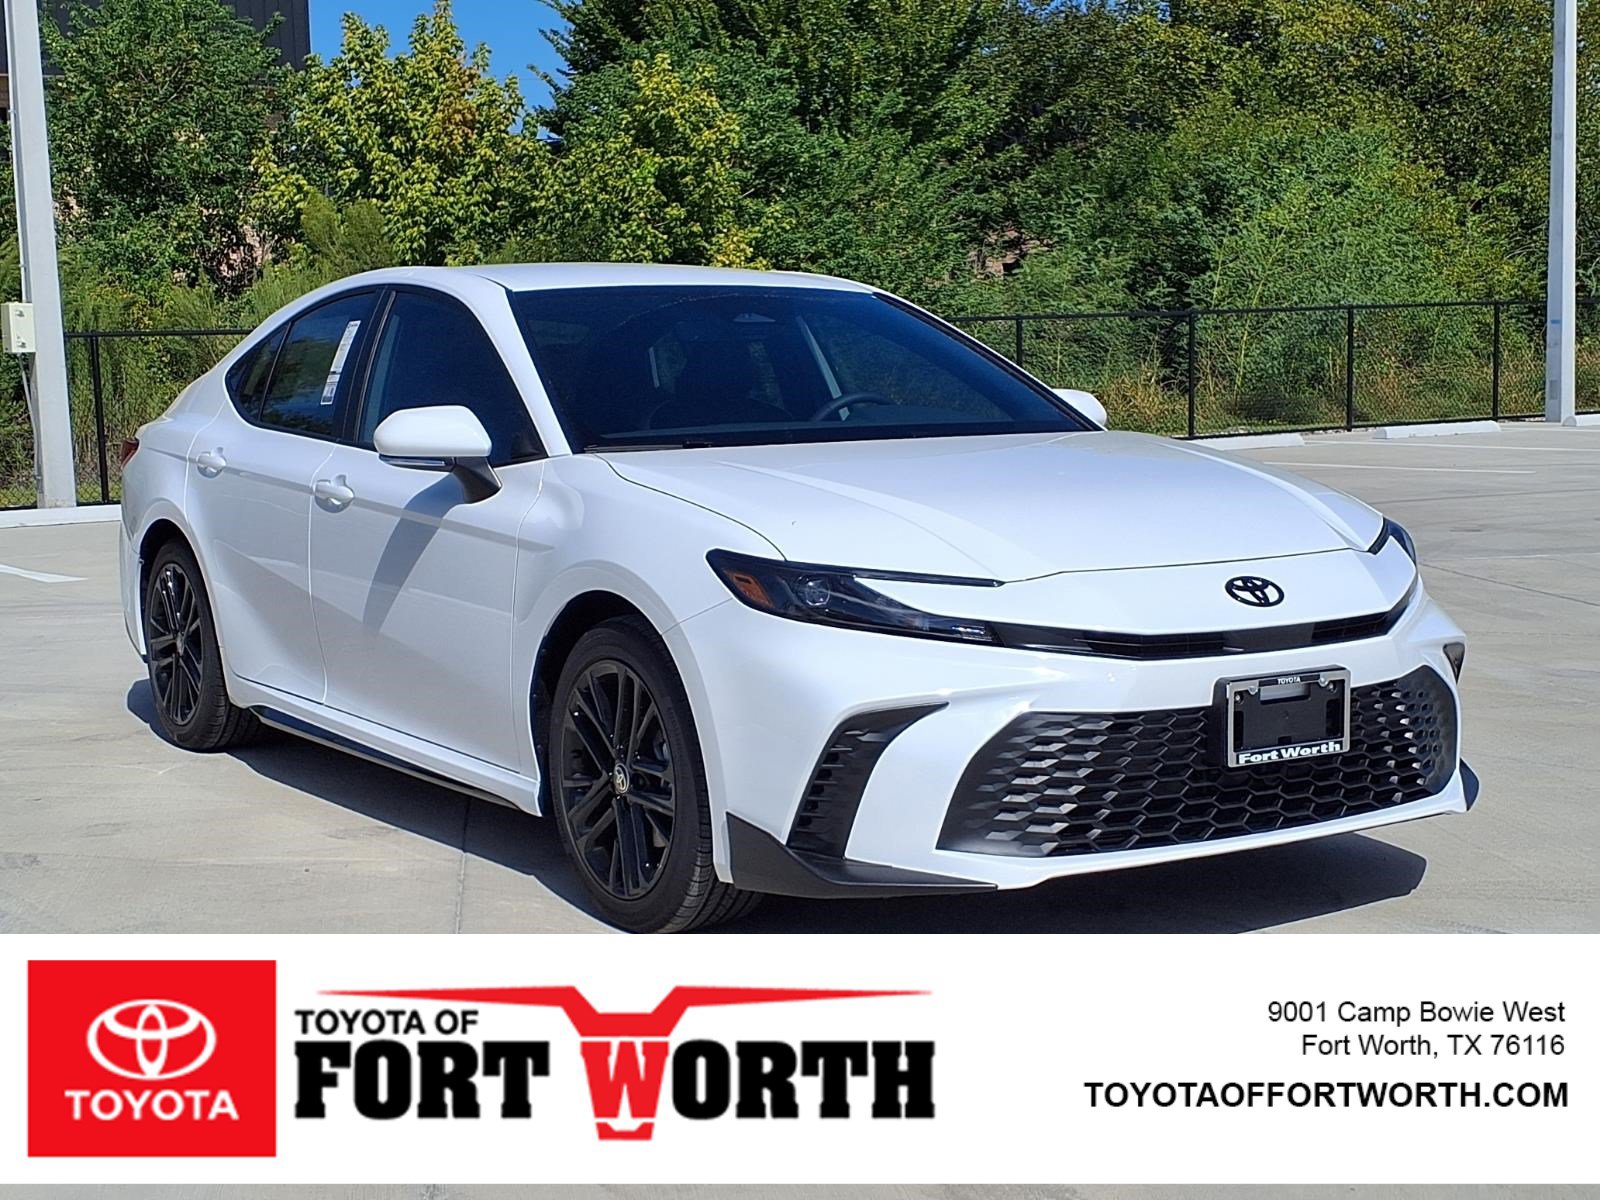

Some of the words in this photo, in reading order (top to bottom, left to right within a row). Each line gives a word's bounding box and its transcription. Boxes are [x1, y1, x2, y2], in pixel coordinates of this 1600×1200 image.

[1277, 676, 1301, 685] TOYOTA
[1238, 750, 1279, 764] Fort
[1280, 741, 1341, 758] Worth
